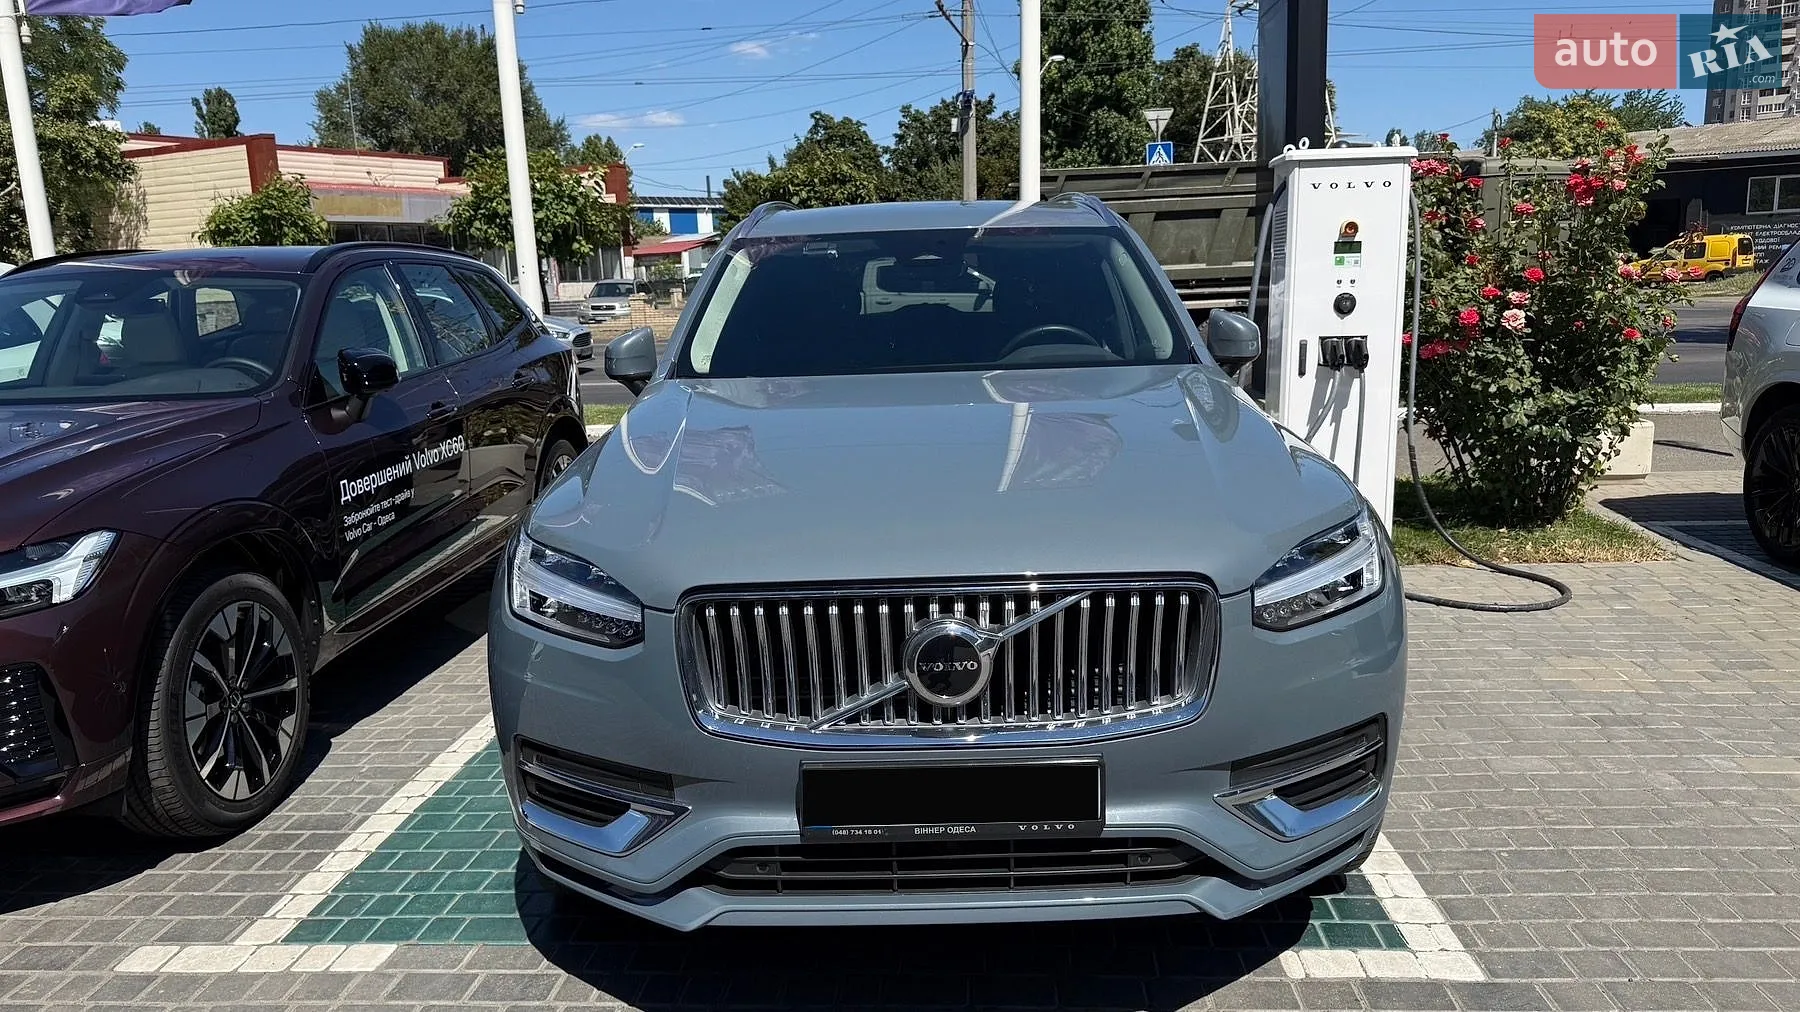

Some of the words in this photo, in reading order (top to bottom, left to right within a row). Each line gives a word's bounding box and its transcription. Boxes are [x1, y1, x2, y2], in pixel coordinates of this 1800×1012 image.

[1311, 180, 1392, 190] VOLVO
[340, 455, 413, 505] Довершений
[412, 447, 440, 470] Volvo
[439, 435, 465, 460] XC60
[343, 503, 381, 527] Забронюйте
[344, 528, 362, 542] Volvo
[361, 521, 373, 534] Car
[377, 511, 396, 526] Одеса
[919, 660, 978, 672] VOLVO
[914, 827, 945, 835] ВІННЕР
[946, 825, 977, 835] ОДЕСА
[1018, 823, 1076, 831] VOLVO
